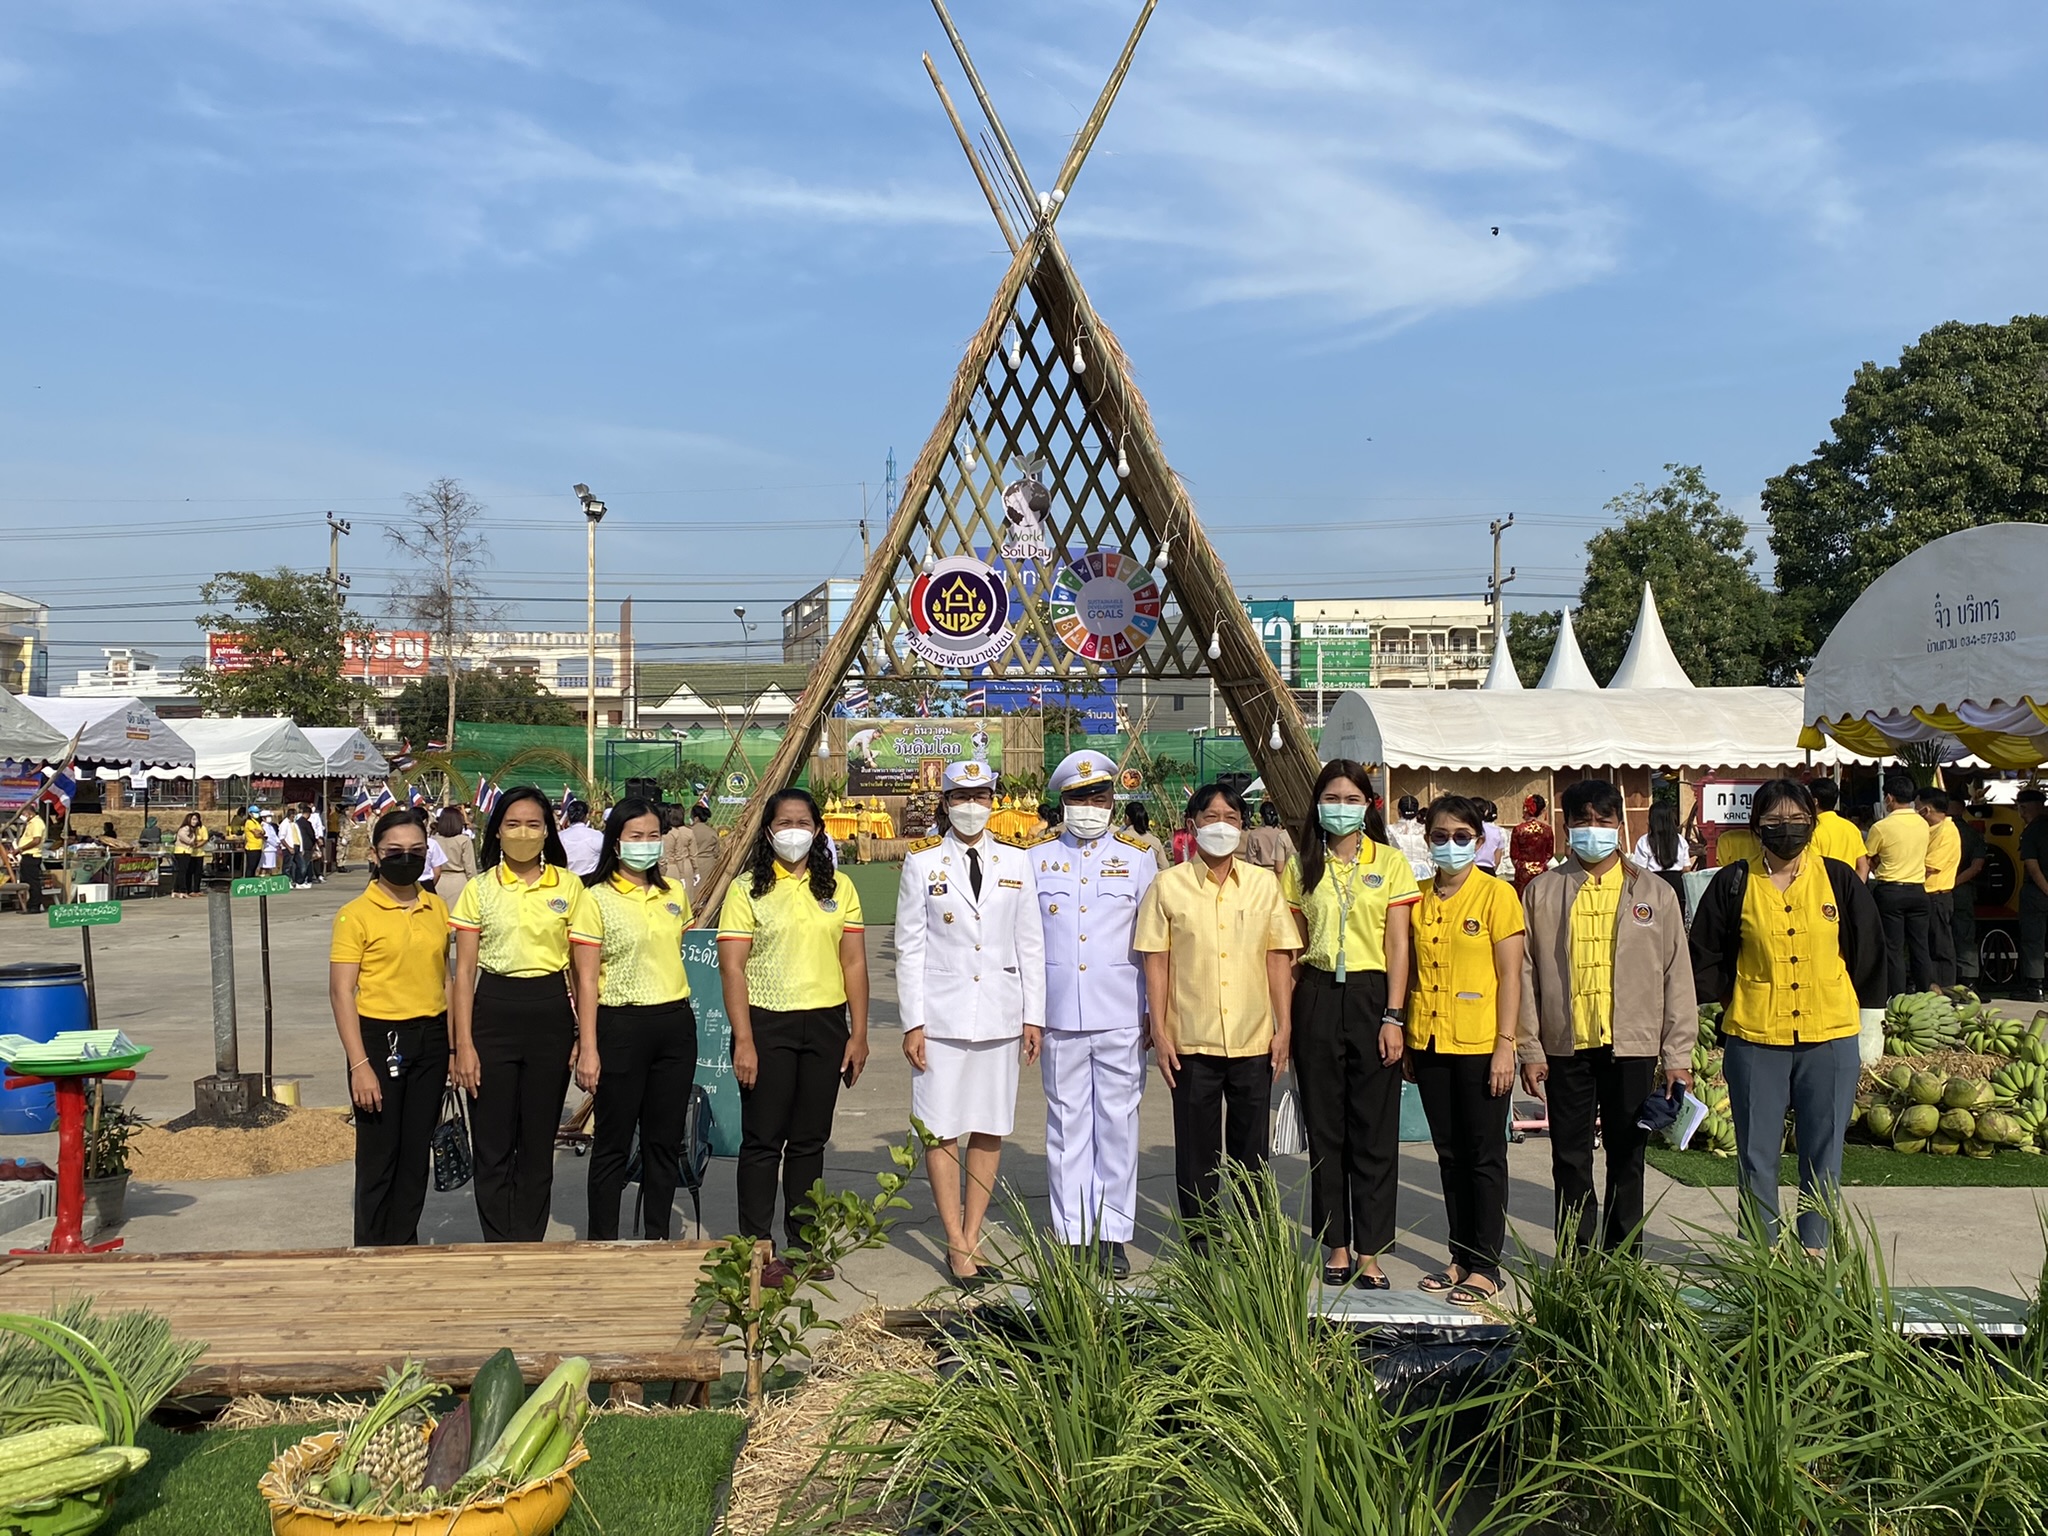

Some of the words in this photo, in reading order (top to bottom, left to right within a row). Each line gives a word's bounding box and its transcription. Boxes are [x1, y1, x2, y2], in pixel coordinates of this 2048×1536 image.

[1008, 529, 1044, 542] World
[1002, 544, 1026, 557] Soil
[1028, 545, 1052, 561] Day
[1087, 609, 1124, 619] GOALS
[1957, 594, 2000, 625] บริการ
[905, 629, 1014, 666] กรมการพัฒนาชุมชน
[1960, 630, 2016, 648] 034-579330
[914, 724, 952, 735] ธันวาคม
[893, 734, 962, 755] วันดินโลก
